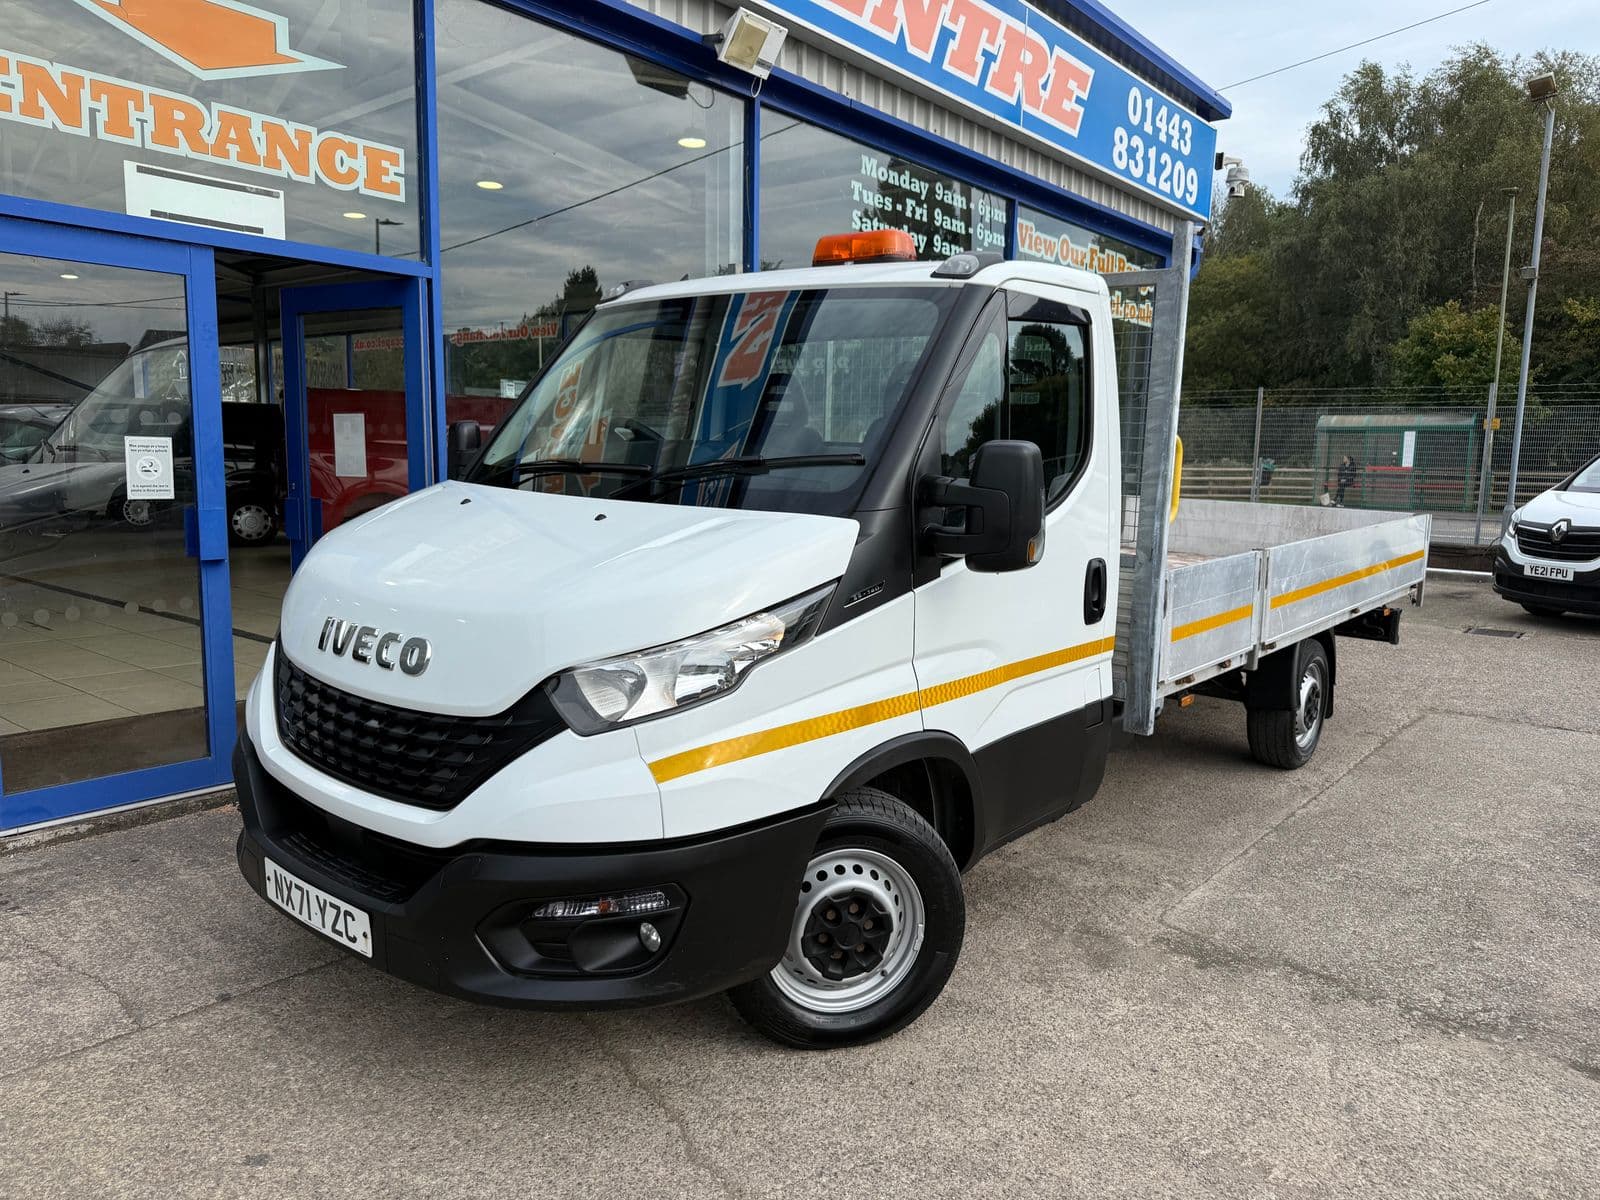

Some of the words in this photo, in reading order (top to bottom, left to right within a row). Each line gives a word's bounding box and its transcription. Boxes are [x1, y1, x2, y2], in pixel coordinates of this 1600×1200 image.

[0, 52, 403, 200] NTRANCE
[1128, 86, 1192, 156] 01443
[861, 154, 930, 200] Monday
[935, 182, 967, 210] 9am
[978, 199, 1006, 224] 6pm
[1113, 126, 1198, 205] 831209
[851, 180, 892, 211] Tues
[905, 198, 928, 223] Fri
[934, 208, 966, 235] 9am
[976, 223, 1005, 247] 6pm
[1018, 218, 1058, 261] View
[1059, 234, 1087, 270] Our
[1088, 244, 1115, 273] Full
[1529, 565, 1548, 577] YE21
[1550, 567, 1568, 579] FPU
[317, 616, 432, 677] IVECO
[273, 869, 311, 921] NX71
[315, 894, 358, 944] YZC
